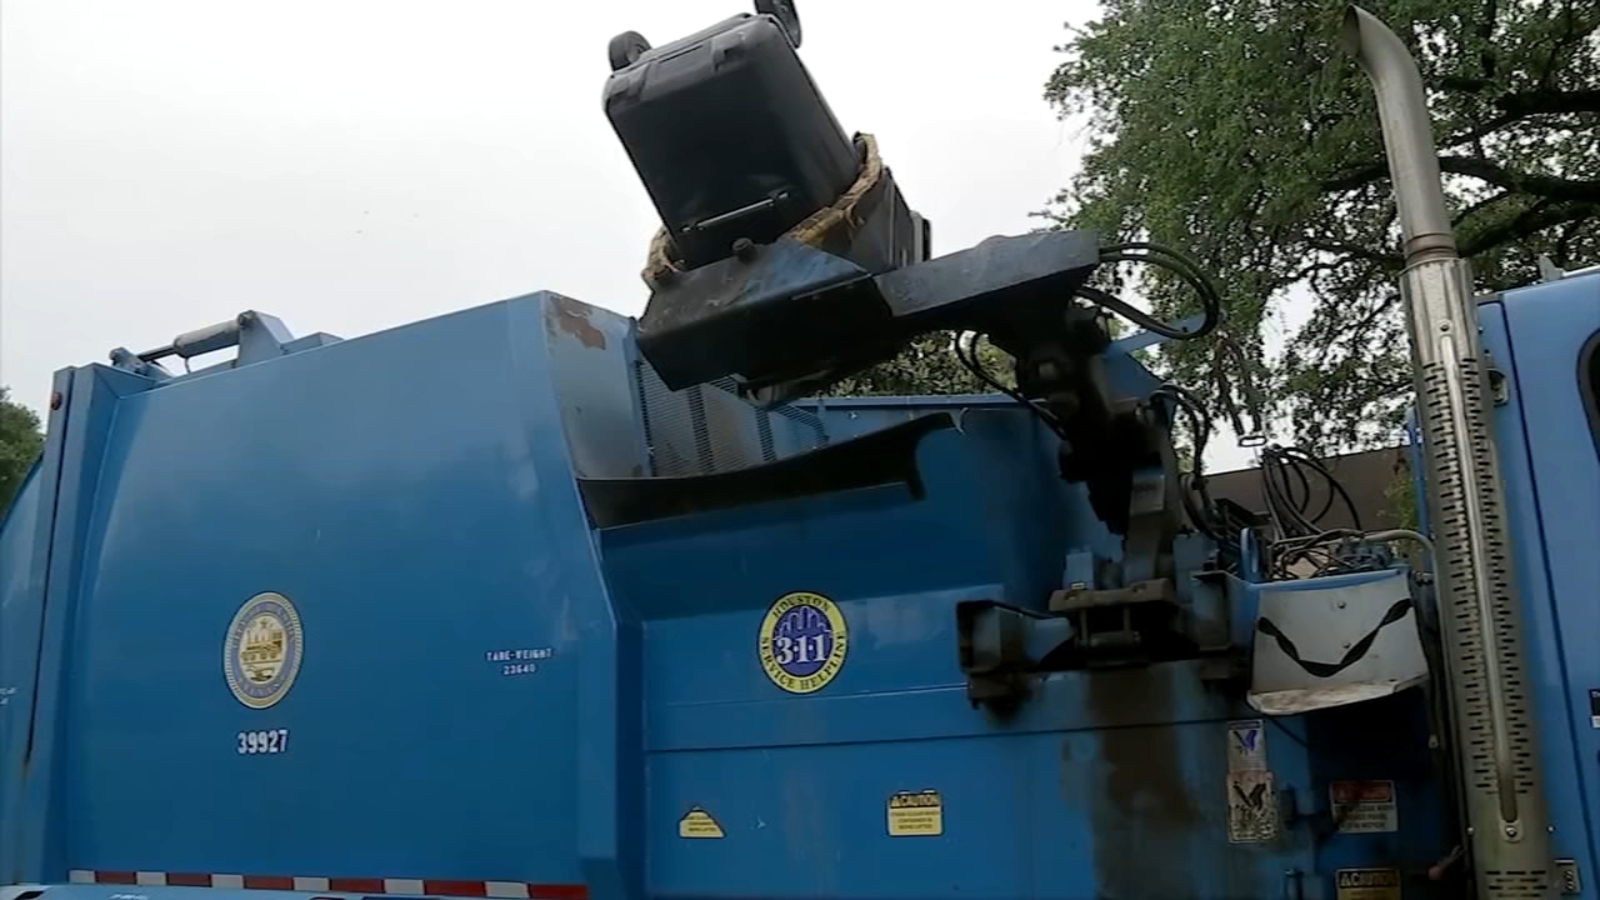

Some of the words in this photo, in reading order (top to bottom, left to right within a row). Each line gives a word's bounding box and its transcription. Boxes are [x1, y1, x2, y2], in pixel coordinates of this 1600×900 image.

[771, 595, 831, 618] HOUSTON
[761, 636, 796, 690] SERVICE
[799, 631, 846, 690] HELPLINE
[237, 730, 289, 755] 39927
[900, 793, 940, 806] CAUTION
